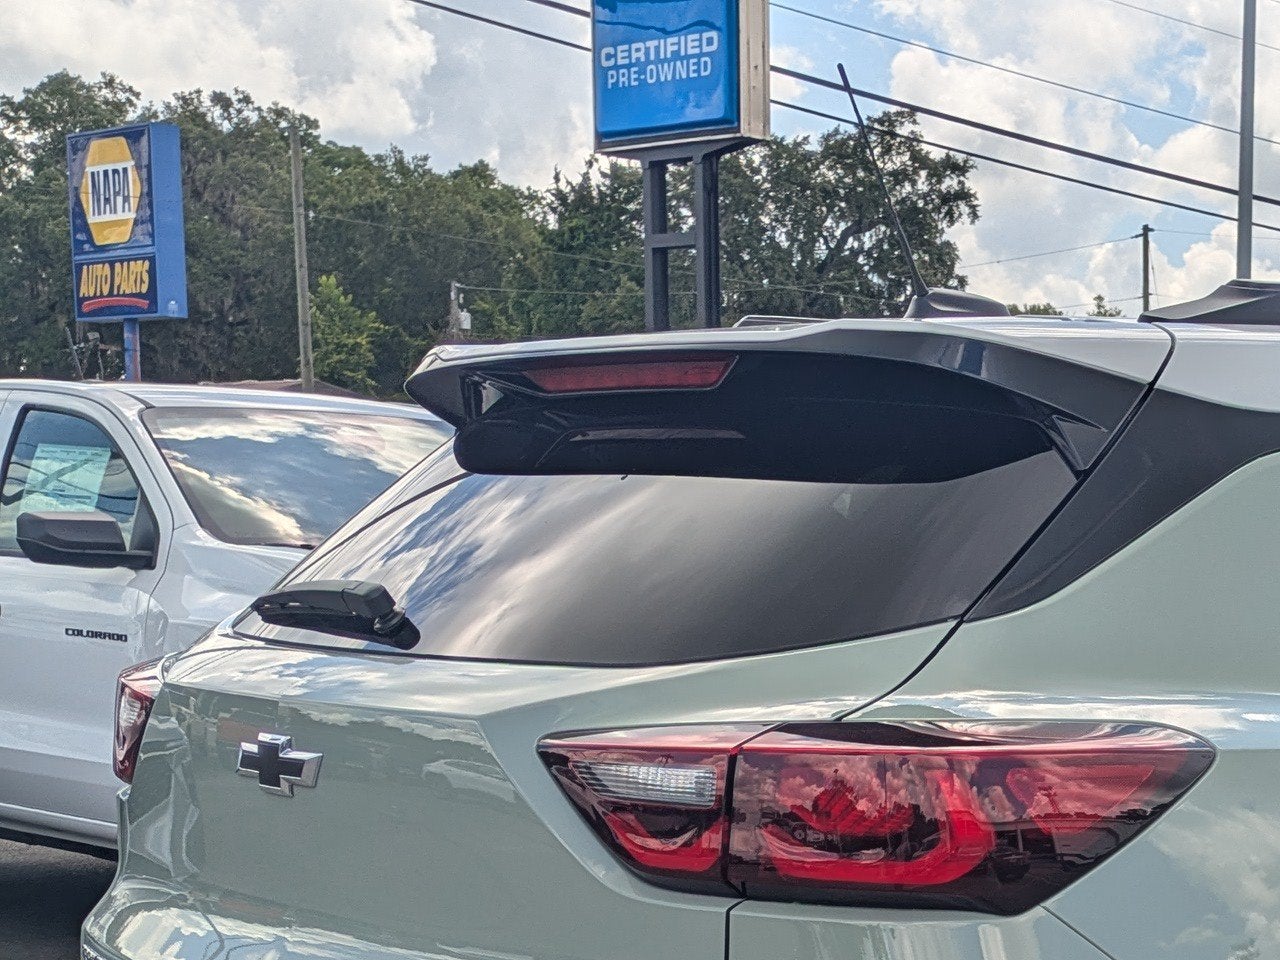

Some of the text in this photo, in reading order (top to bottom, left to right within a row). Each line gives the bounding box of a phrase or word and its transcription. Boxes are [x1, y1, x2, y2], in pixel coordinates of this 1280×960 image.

[601, 31, 719, 68] CERTIFIED
[607, 57, 712, 89] PRE-OWNED
[90, 167, 132, 218] NAPA
[79, 260, 150, 298] AUTO PARTS
[65, 628, 128, 642] COLORADO
